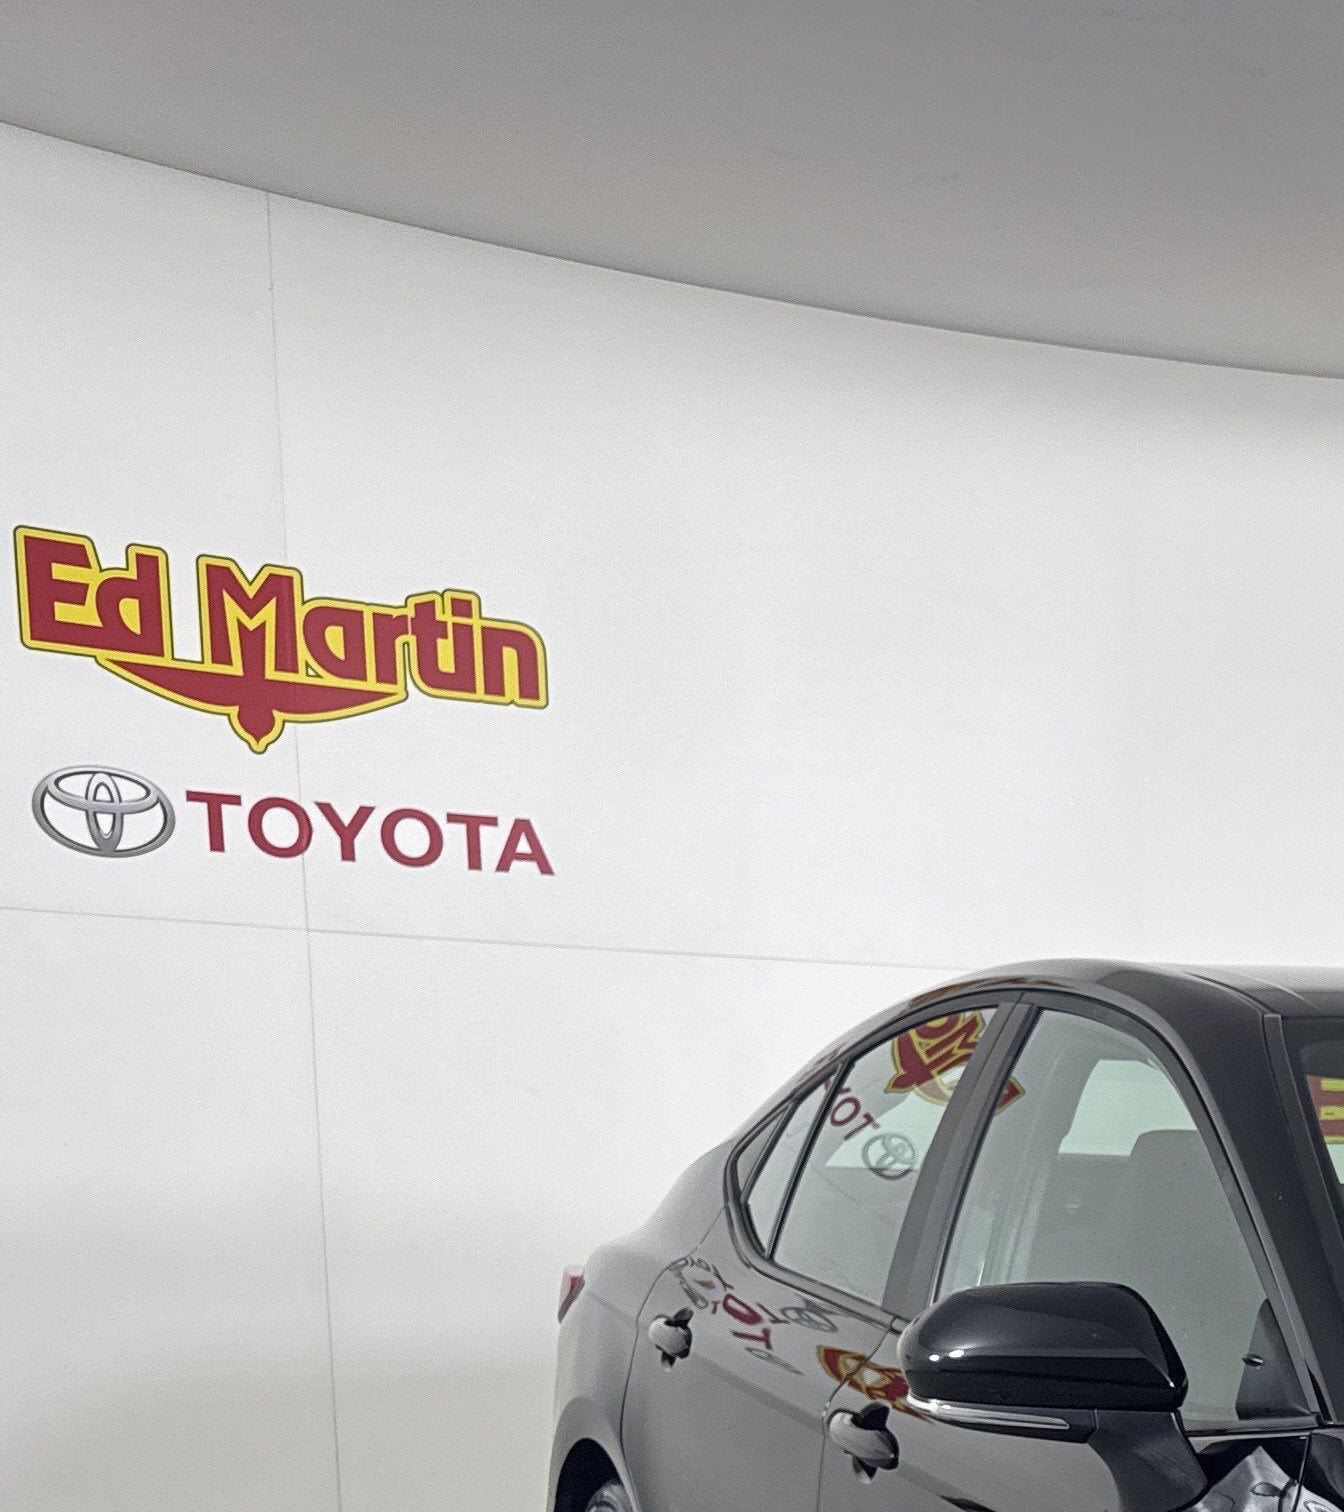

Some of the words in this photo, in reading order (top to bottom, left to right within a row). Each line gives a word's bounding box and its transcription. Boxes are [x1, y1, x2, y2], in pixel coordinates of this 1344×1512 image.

[14, 525, 171, 660] Ed
[197, 554, 549, 708] Martin
[186, 789, 555, 876] TOYOTA
